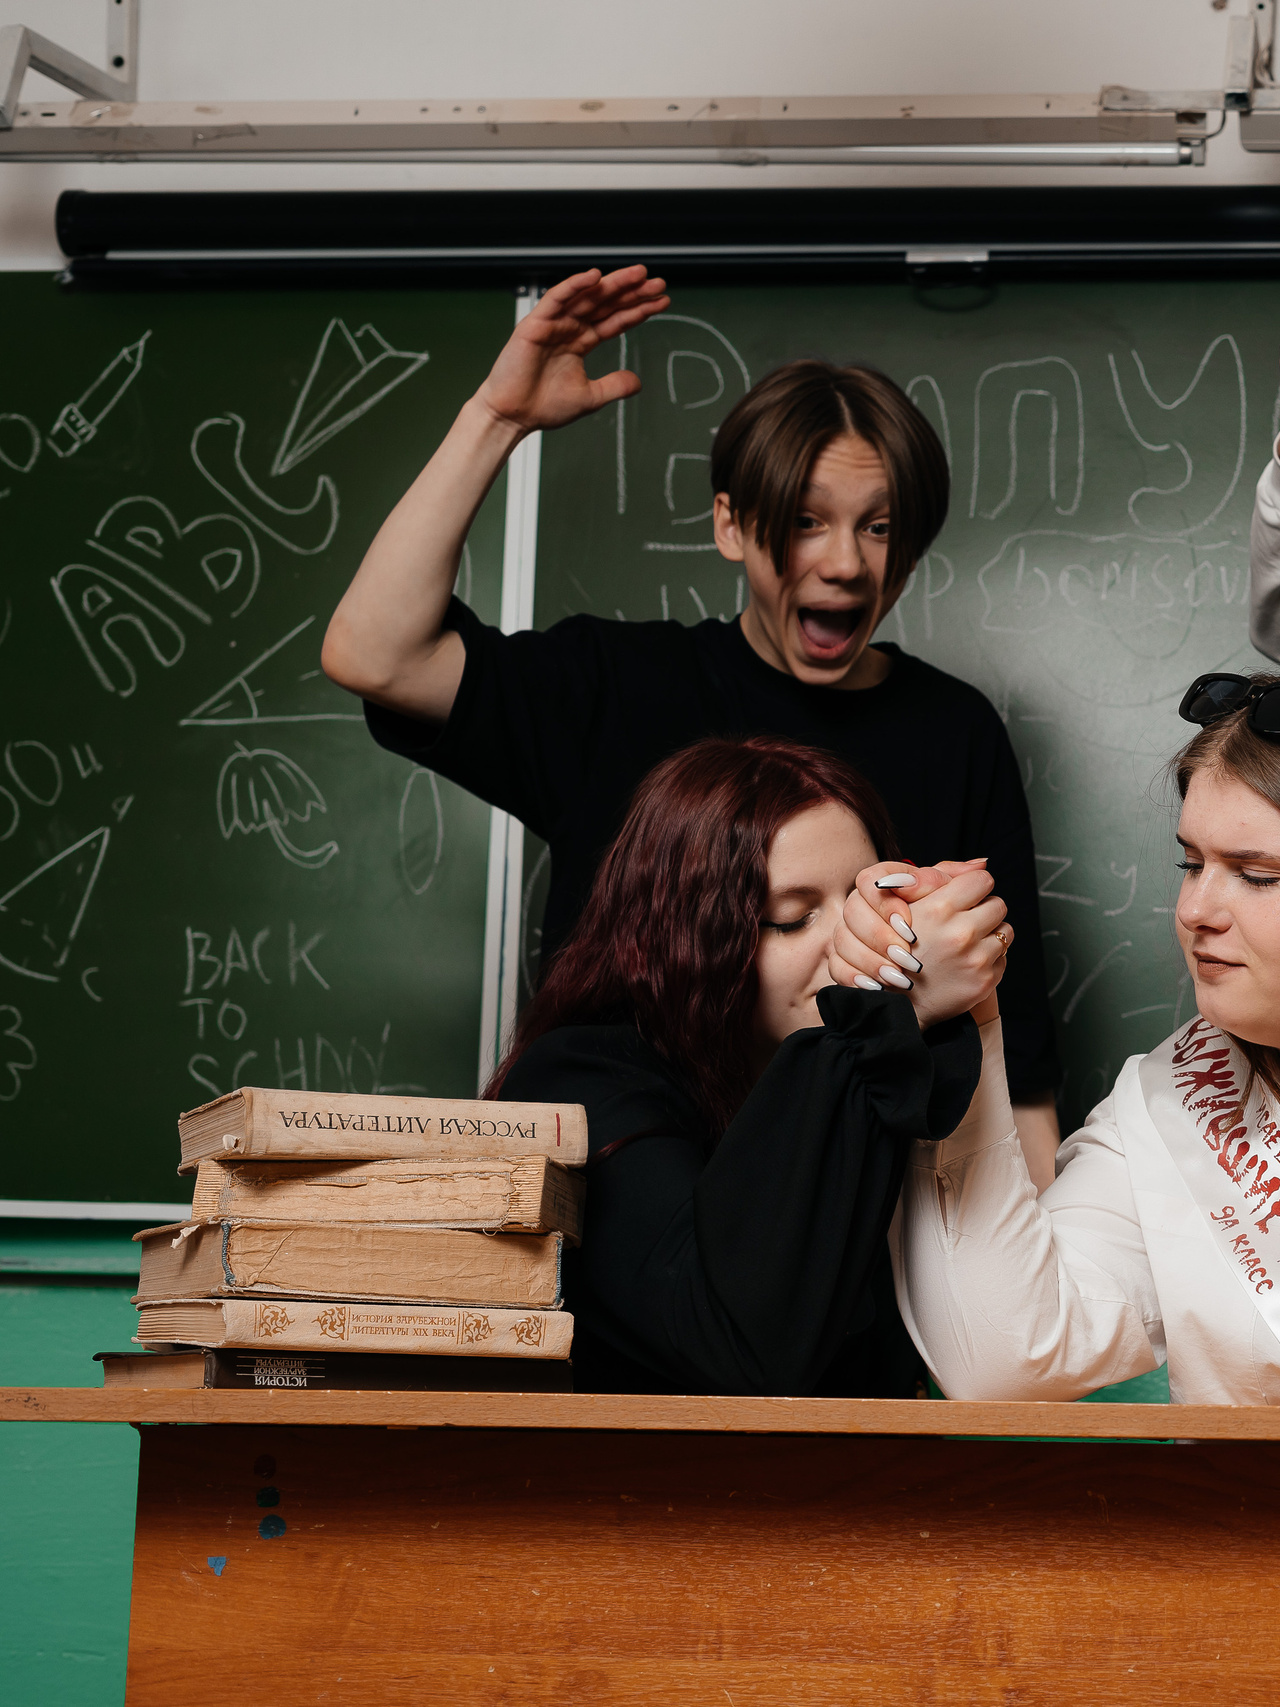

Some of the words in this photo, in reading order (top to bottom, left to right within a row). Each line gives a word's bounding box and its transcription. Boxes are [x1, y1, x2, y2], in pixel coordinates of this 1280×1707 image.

[50, 411, 340, 699] ABC
[183, 920, 332, 995] BACK
[178, 997, 249, 1042] TO
[277, 1110, 432, 1135] ЛИТЕРАТУРА
[438, 1116, 538, 1139] РУССКАЯ
[1229, 1233, 1274, 1295] КЛАСС
[351, 1314, 393, 1324] ИСТОРИЯ
[396, 1315, 457, 1326] ЗАРУБЕЖНОЙ
[351, 1325, 409, 1336] ЛИТЕРАТУРЫ
[432, 1328, 456, 1338] ВЕКА
[253, 1366, 308, 1376] ЗАРУБЕЖНОЙ
[255, 1358, 306, 1368] ЛИТЕРАТУРЫ
[254, 1375, 308, 1387] ИСТОРИЯ
